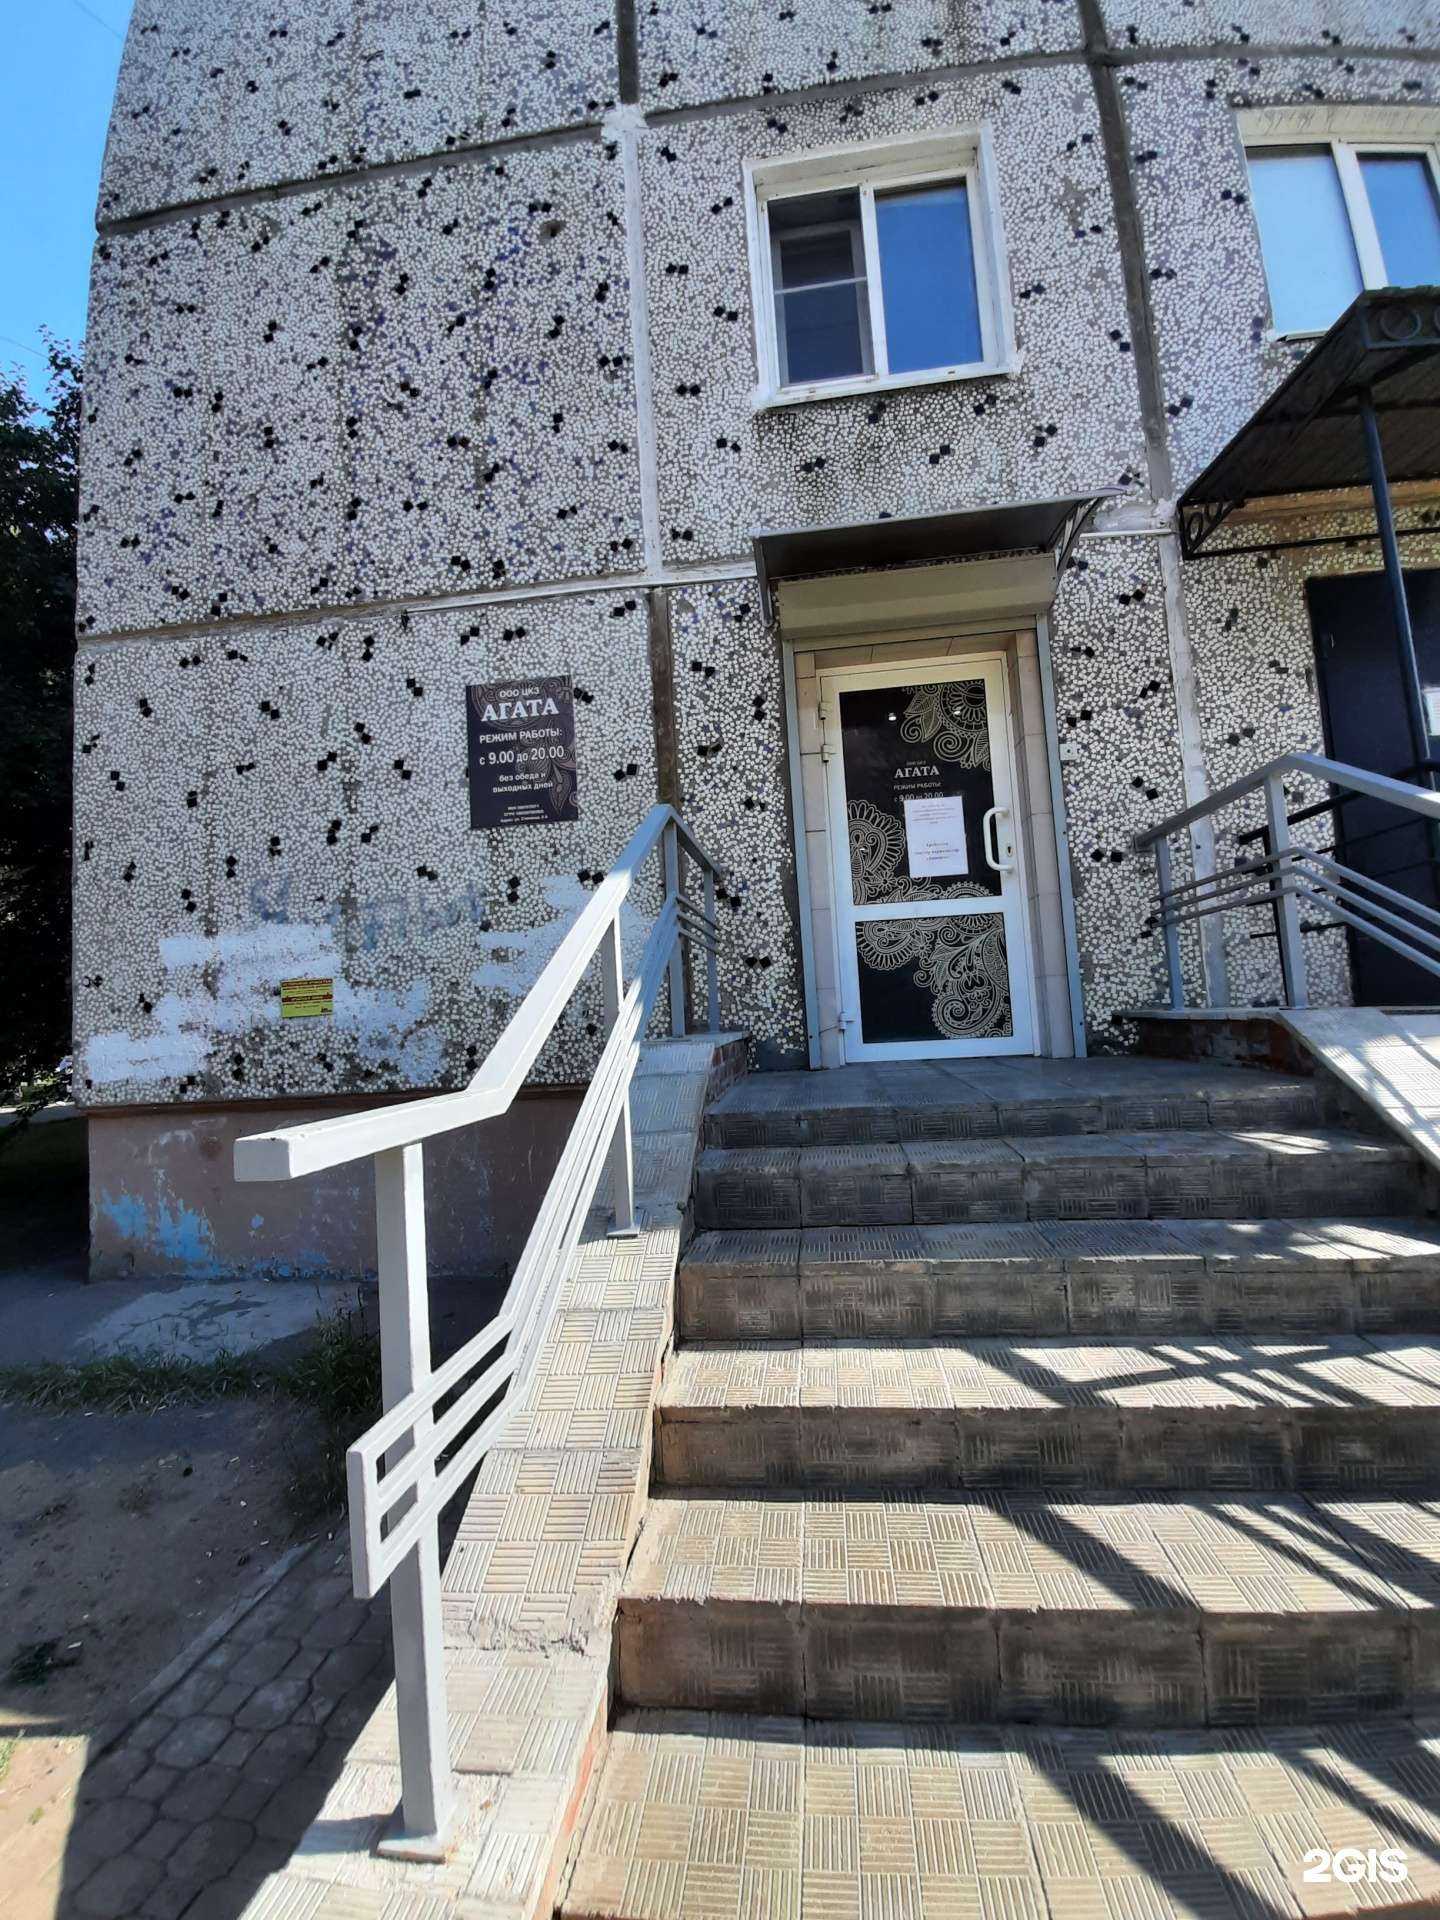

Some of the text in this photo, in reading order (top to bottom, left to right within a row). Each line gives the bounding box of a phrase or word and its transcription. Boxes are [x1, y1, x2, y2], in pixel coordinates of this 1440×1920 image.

[481, 697, 560, 722] АГАТА
[479, 728, 563, 744] РЕЖИМ РАБОТЫ:
[479, 745, 565, 765] с 9.00 до 20.00
[499, 774, 514, 782] без
[515, 772, 540, 781] обеда
[894, 766, 940, 778] АГАТА
[492, 784, 532, 793] выходных
